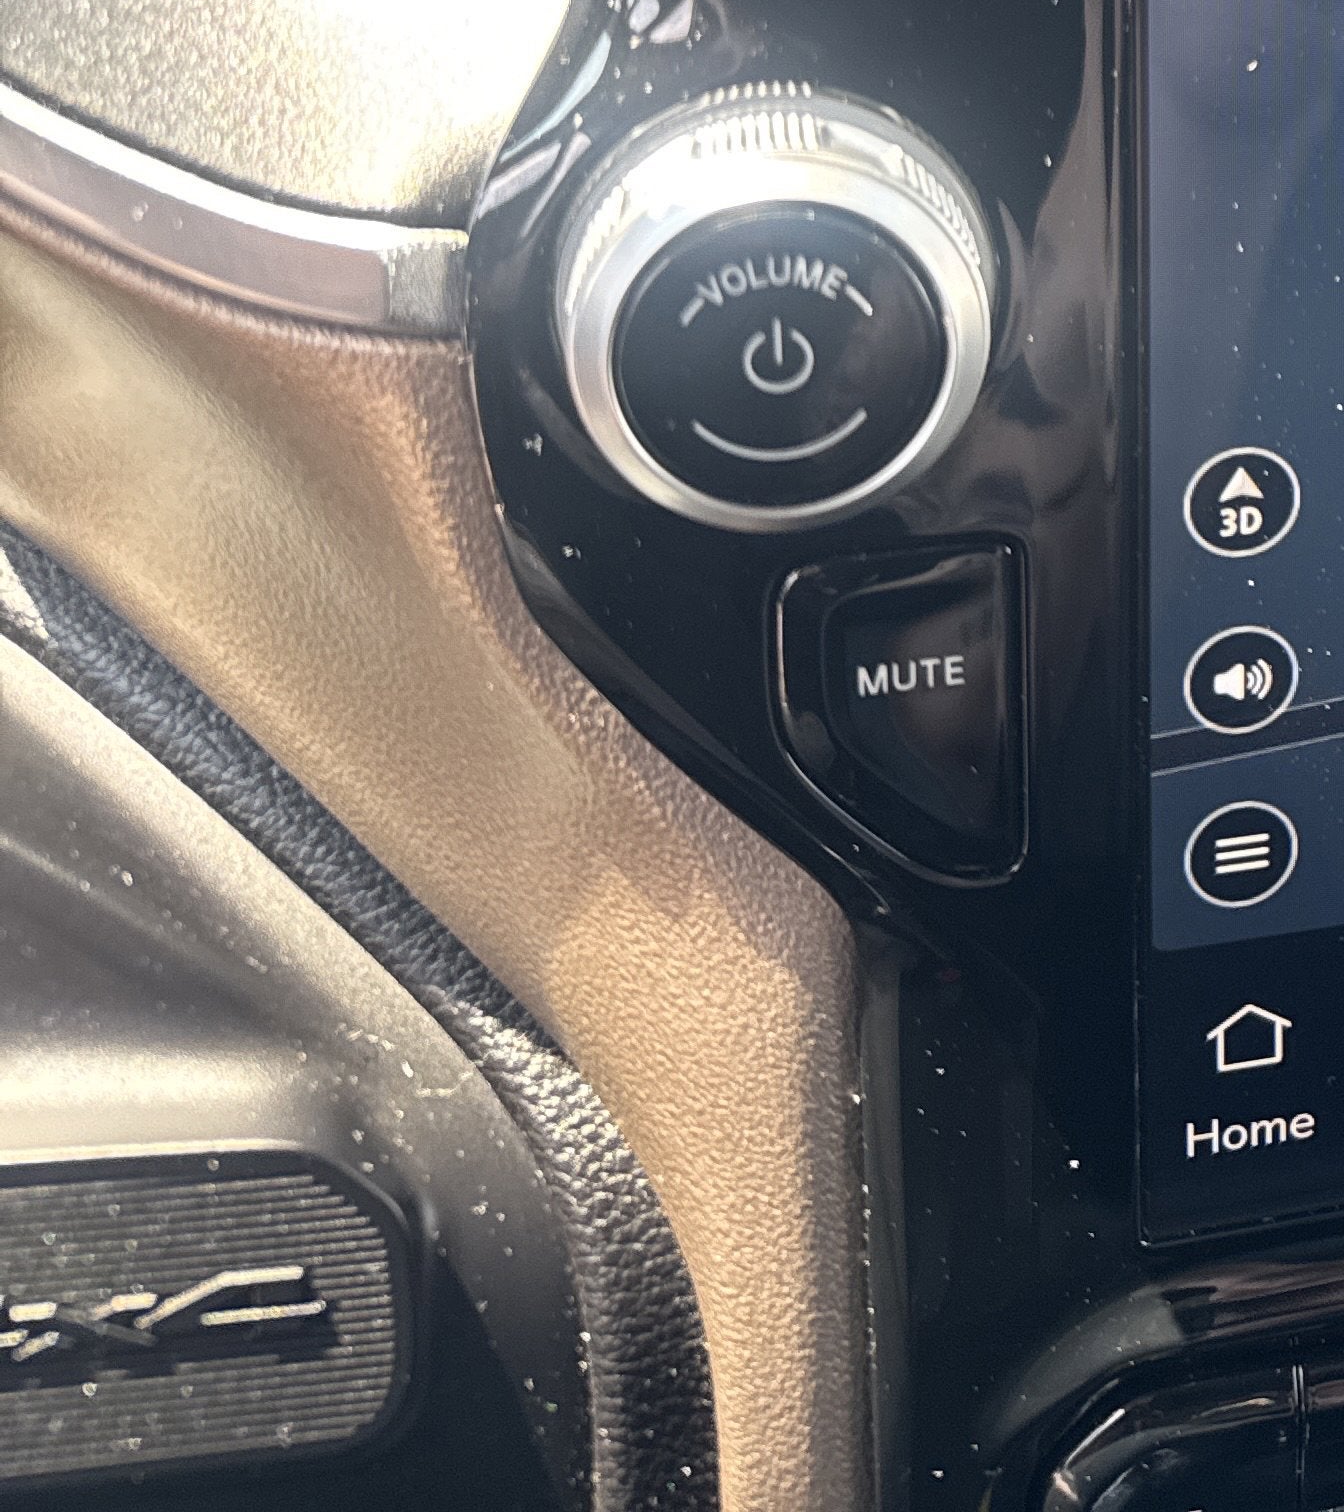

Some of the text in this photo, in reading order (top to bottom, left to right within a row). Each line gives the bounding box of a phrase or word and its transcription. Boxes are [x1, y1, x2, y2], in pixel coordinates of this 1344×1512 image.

[695, 254, 848, 306] VOLUME
[1218, 506, 1262, 539] 3D
[856, 654, 966, 698] MUTE
[1185, 1110, 1315, 1159] Home
